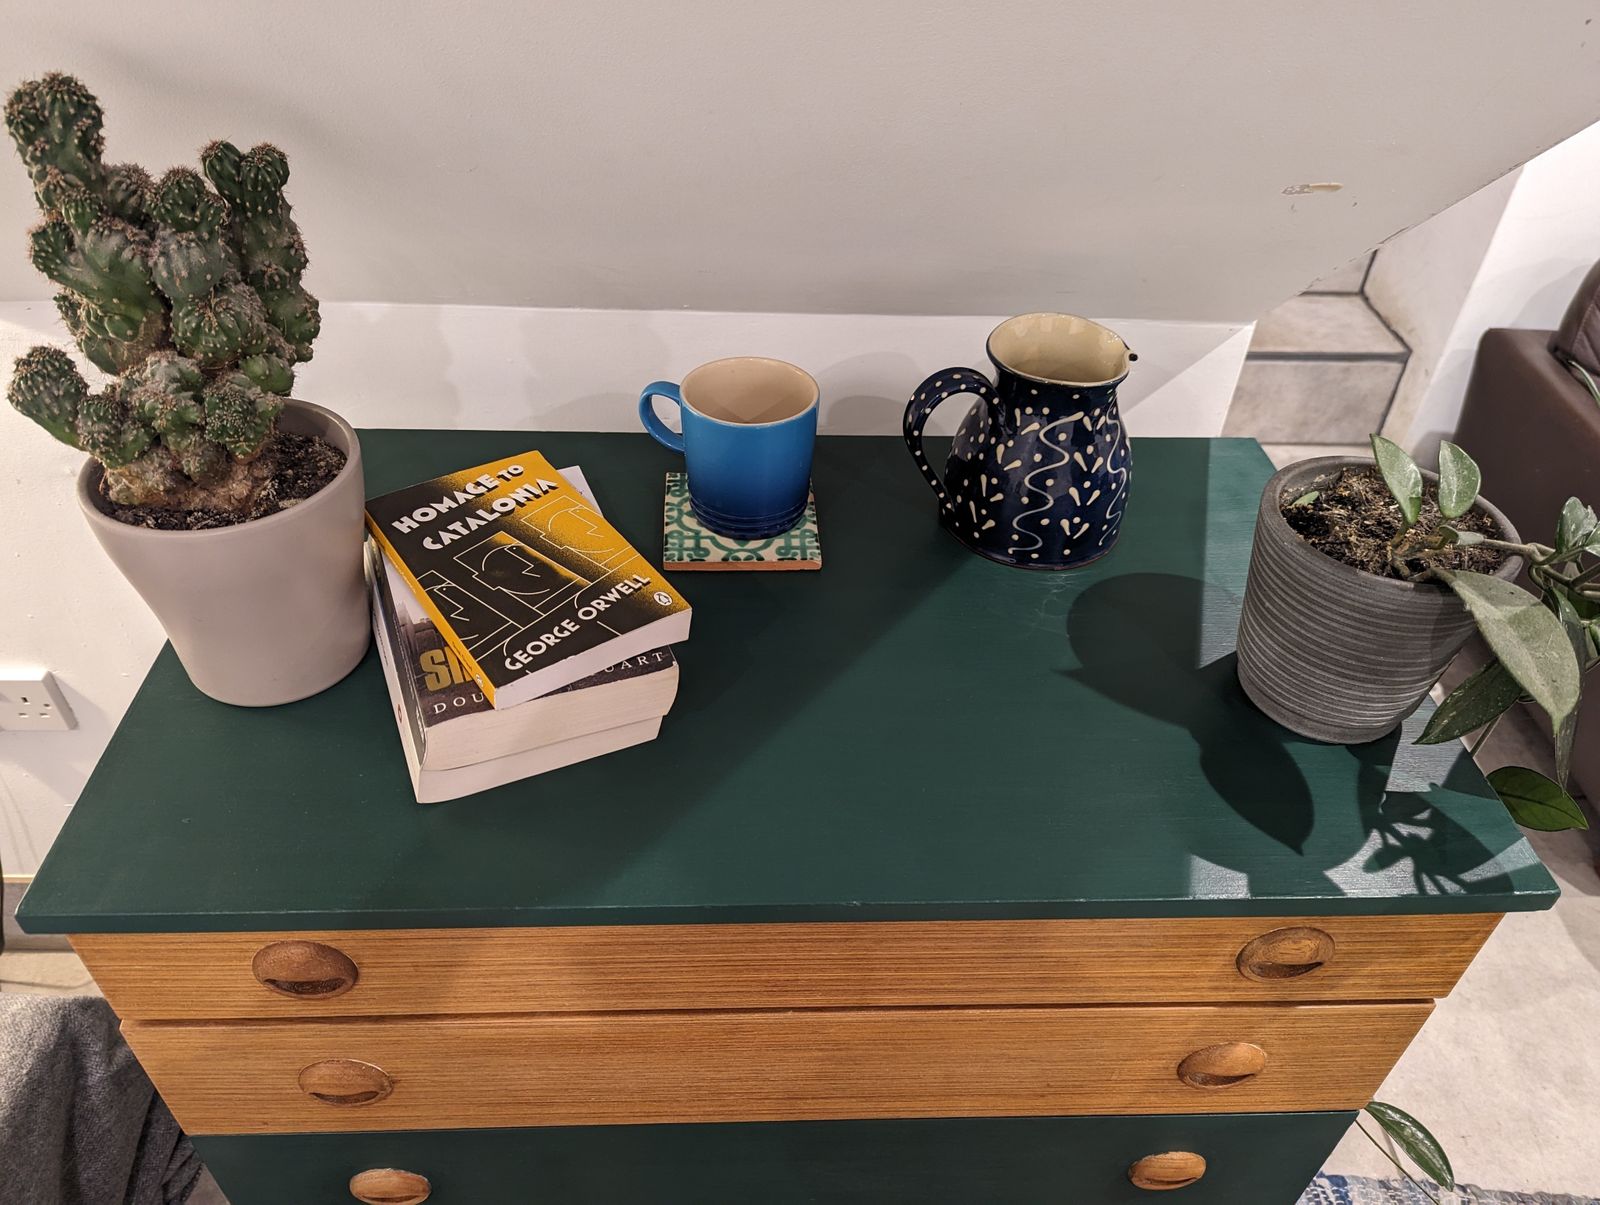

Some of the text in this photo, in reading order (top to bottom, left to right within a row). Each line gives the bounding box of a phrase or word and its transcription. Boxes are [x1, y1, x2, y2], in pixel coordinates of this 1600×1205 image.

[391, 464, 524, 534] HOMAGE TO
[422, 478, 558, 550] CATALONIA
[504, 618, 581, 671] GEORGE
[577, 574, 651, 621] ORWELL
